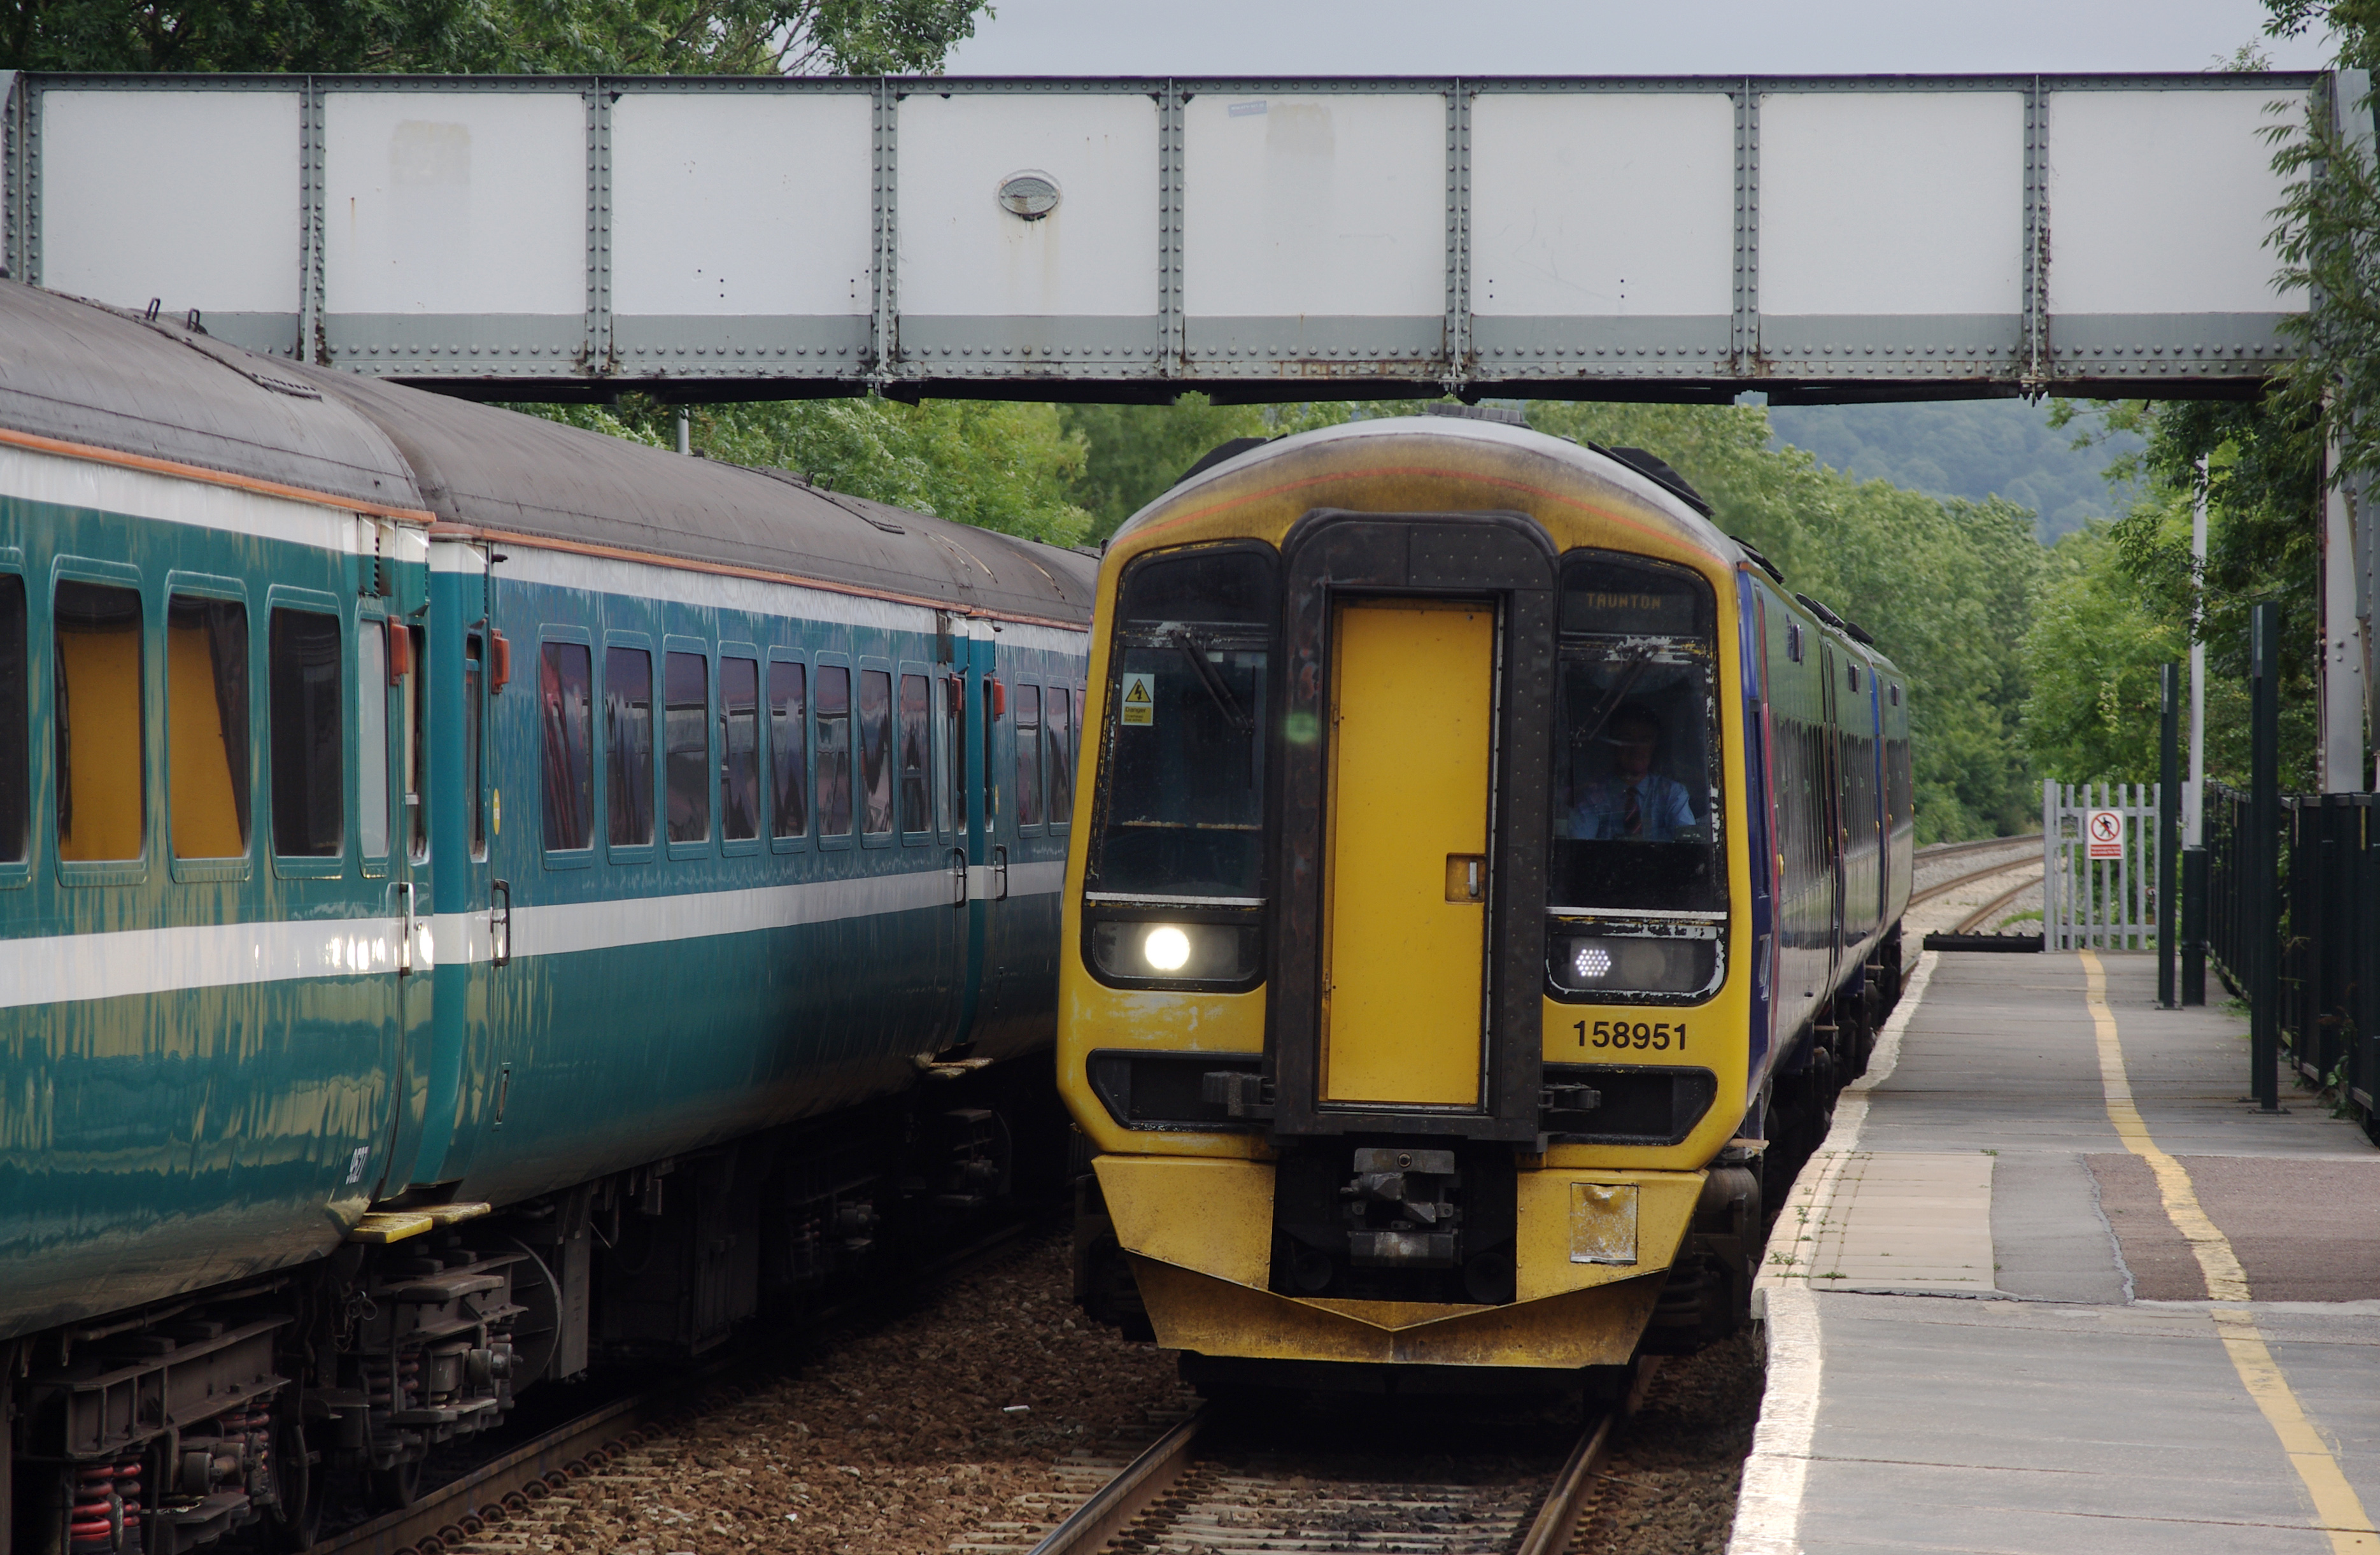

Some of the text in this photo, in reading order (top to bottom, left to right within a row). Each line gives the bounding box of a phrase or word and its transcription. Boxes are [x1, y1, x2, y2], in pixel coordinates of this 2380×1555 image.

[1587, 593, 1661, 609] TAUNTON
[1573, 1020, 1686, 1051] 158951
[345, 1146, 369, 1185] 9527
